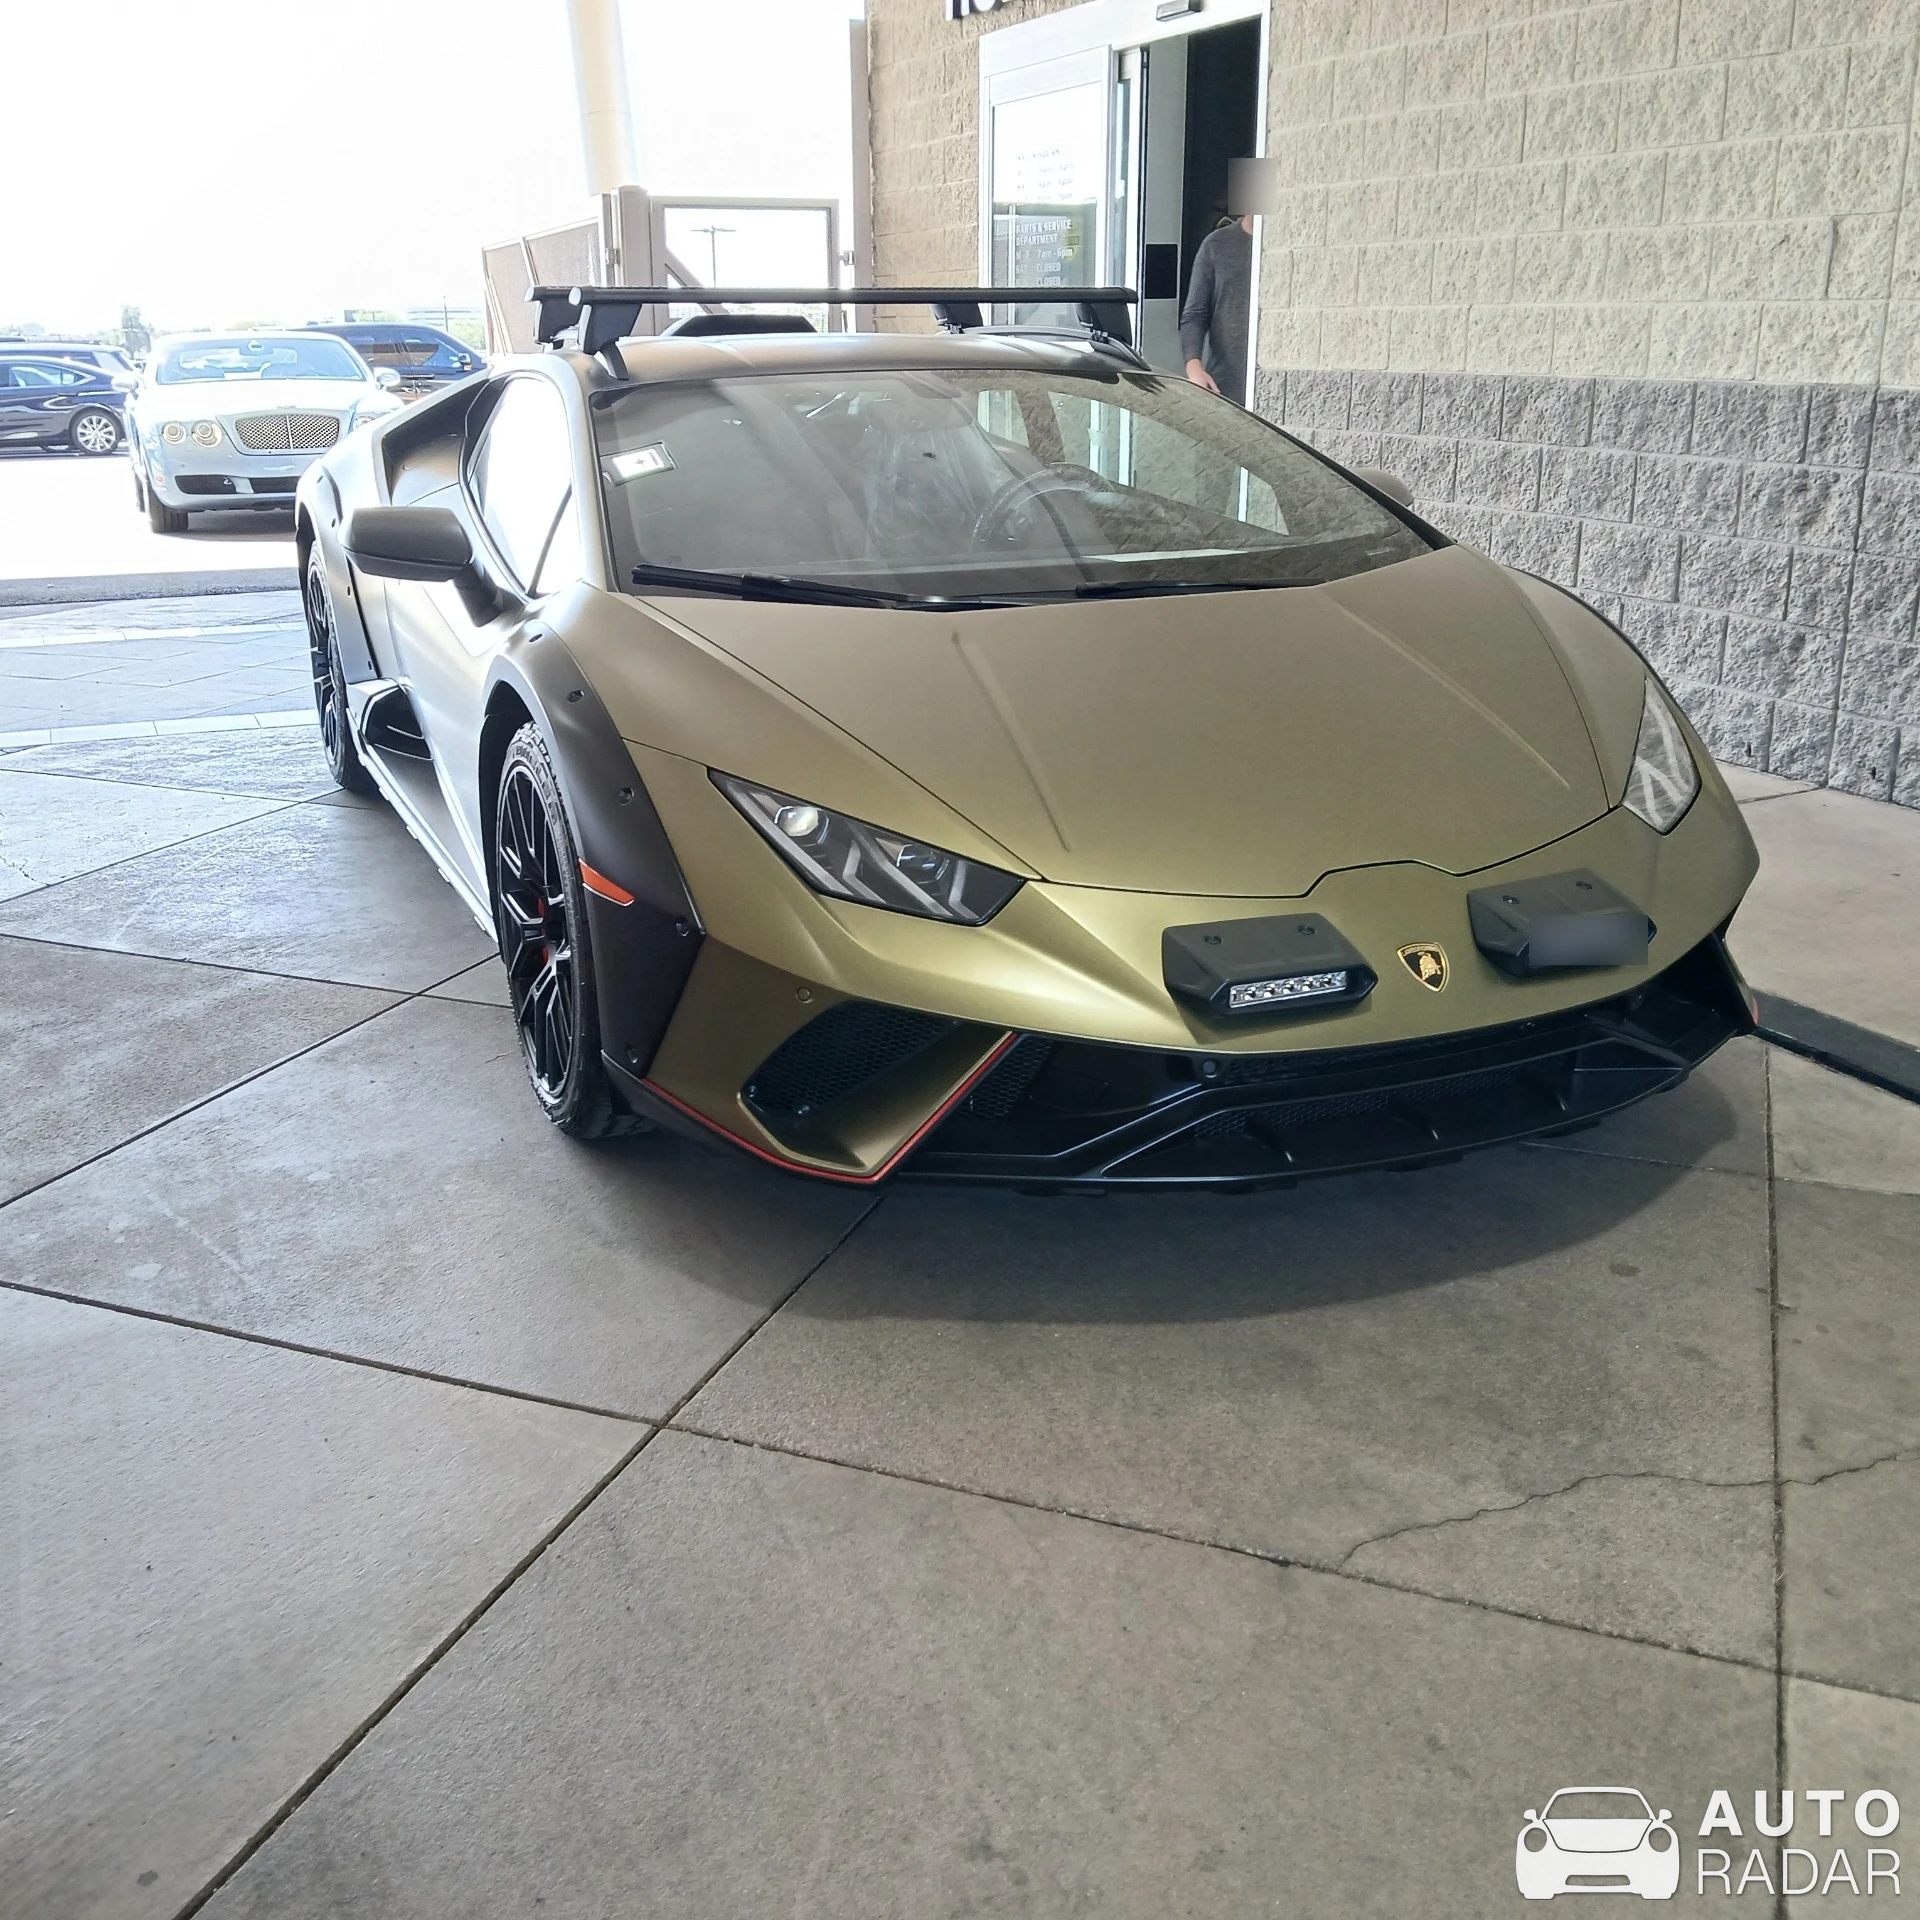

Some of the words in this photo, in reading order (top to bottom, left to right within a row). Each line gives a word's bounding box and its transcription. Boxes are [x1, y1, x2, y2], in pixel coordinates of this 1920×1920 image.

[1016, 223, 1036, 235] PARTS
[1044, 219, 1072, 231] SERVICE
[1016, 233, 1058, 246] DEPARTMENT
[1037, 262, 1061, 273] CLOSED
[1037, 276, 1061, 286] CLOSED
